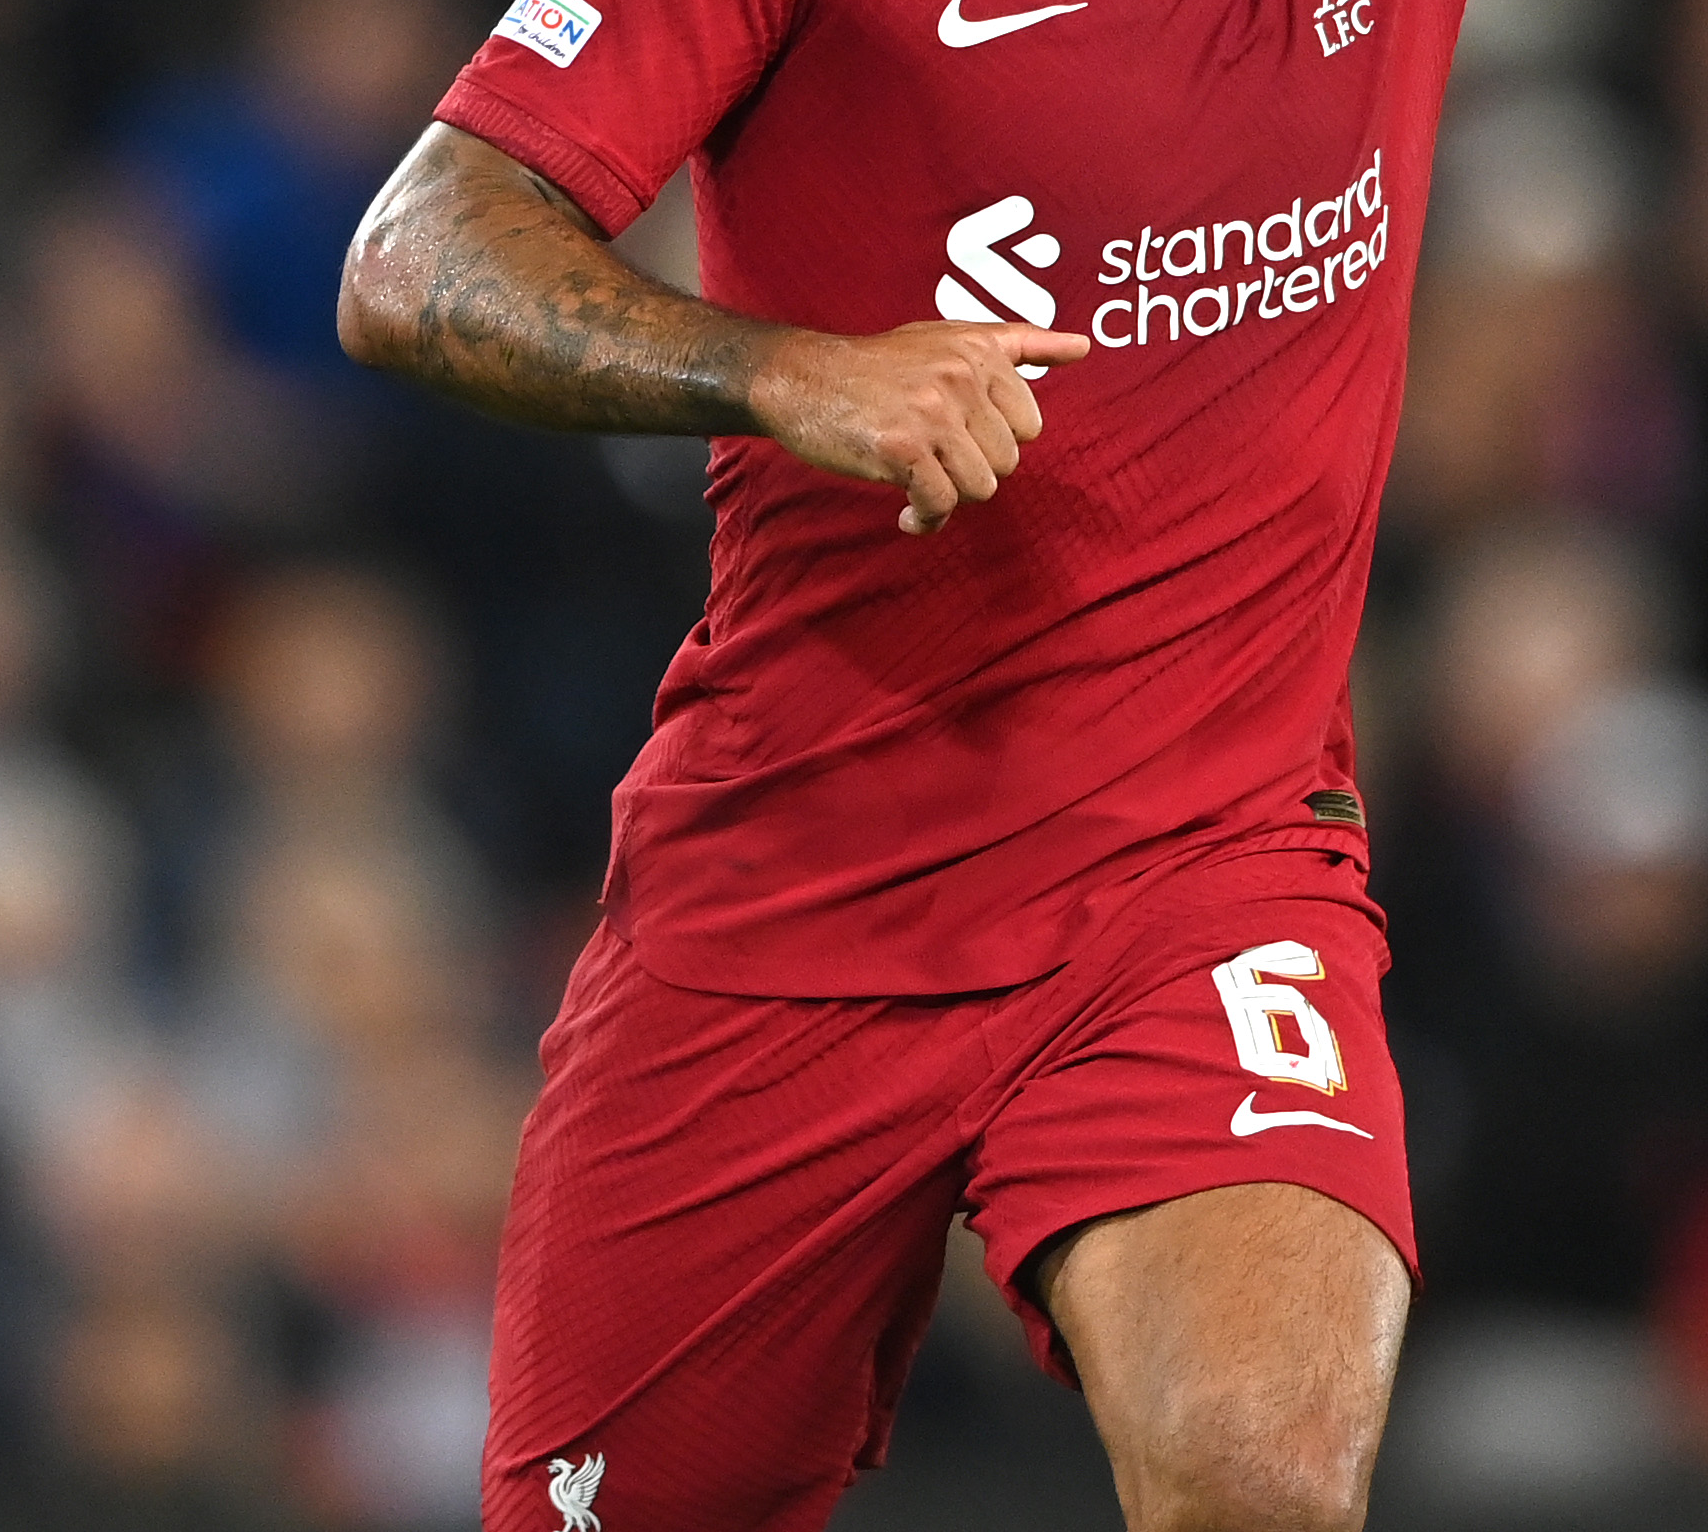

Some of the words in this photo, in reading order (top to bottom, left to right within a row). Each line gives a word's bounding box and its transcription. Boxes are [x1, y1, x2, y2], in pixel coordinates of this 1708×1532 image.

[527, 31, 566, 60] children
[1091, 204, 1389, 349] chartered
[1097, 148, 1382, 286] standard
[1210, 939, 1348, 1097] 6
